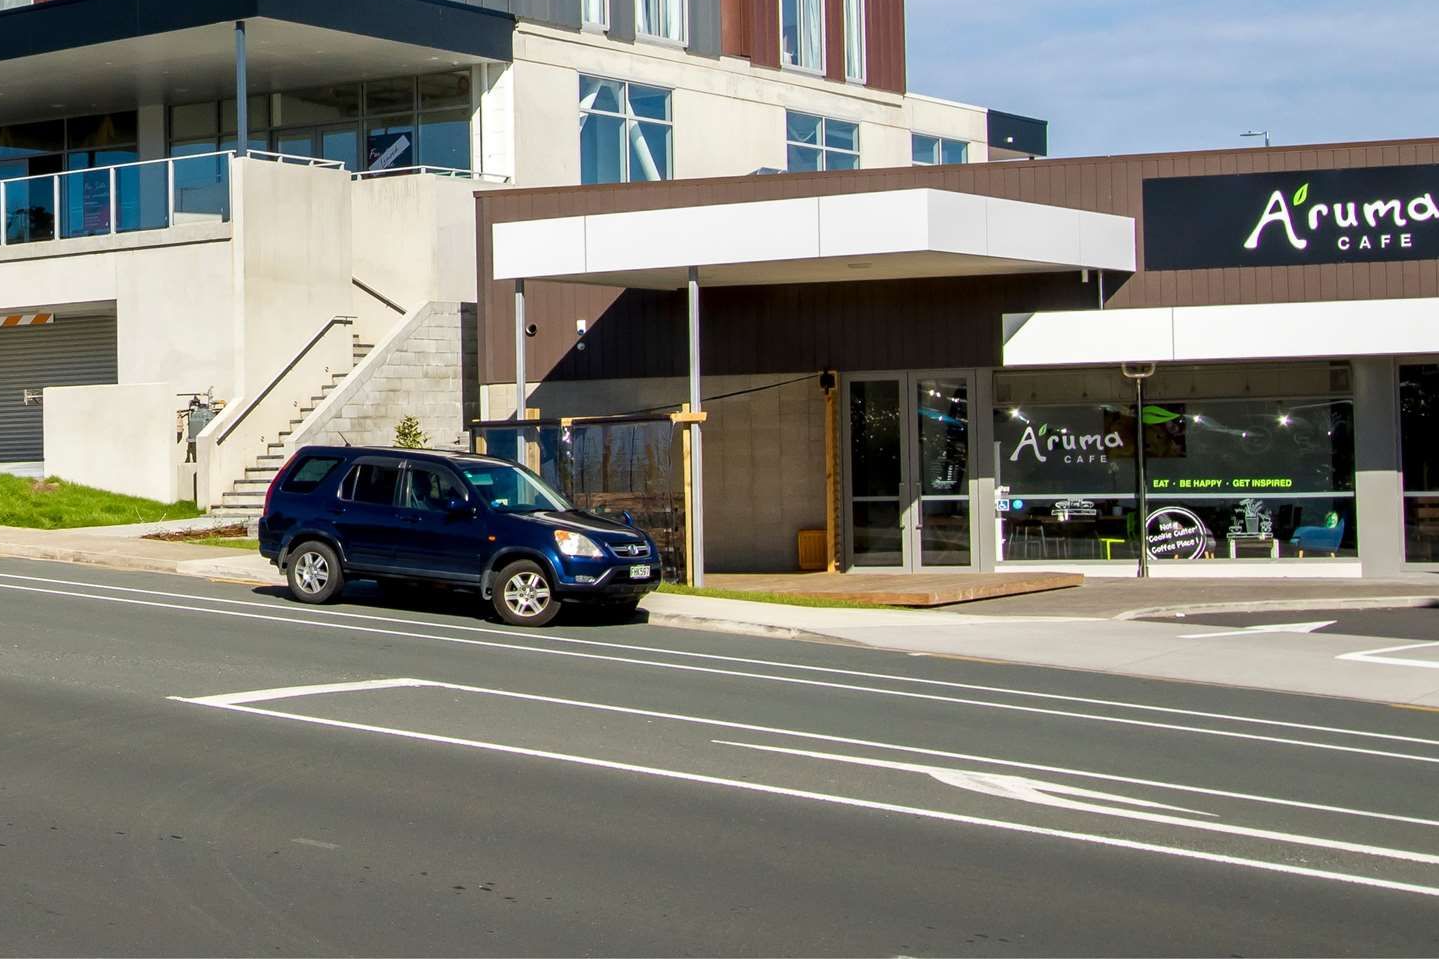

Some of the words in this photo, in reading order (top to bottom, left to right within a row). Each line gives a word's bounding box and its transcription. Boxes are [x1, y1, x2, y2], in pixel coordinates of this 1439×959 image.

[1337, 233, 1412, 250] CAFE
[1064, 455, 1108, 463] CAFE
[1232, 479, 1250, 487] GET
[1252, 479, 1292, 487] INSPIRED
[1160, 523, 1172, 531] Not
[1151, 544, 1176, 553] Coffee
